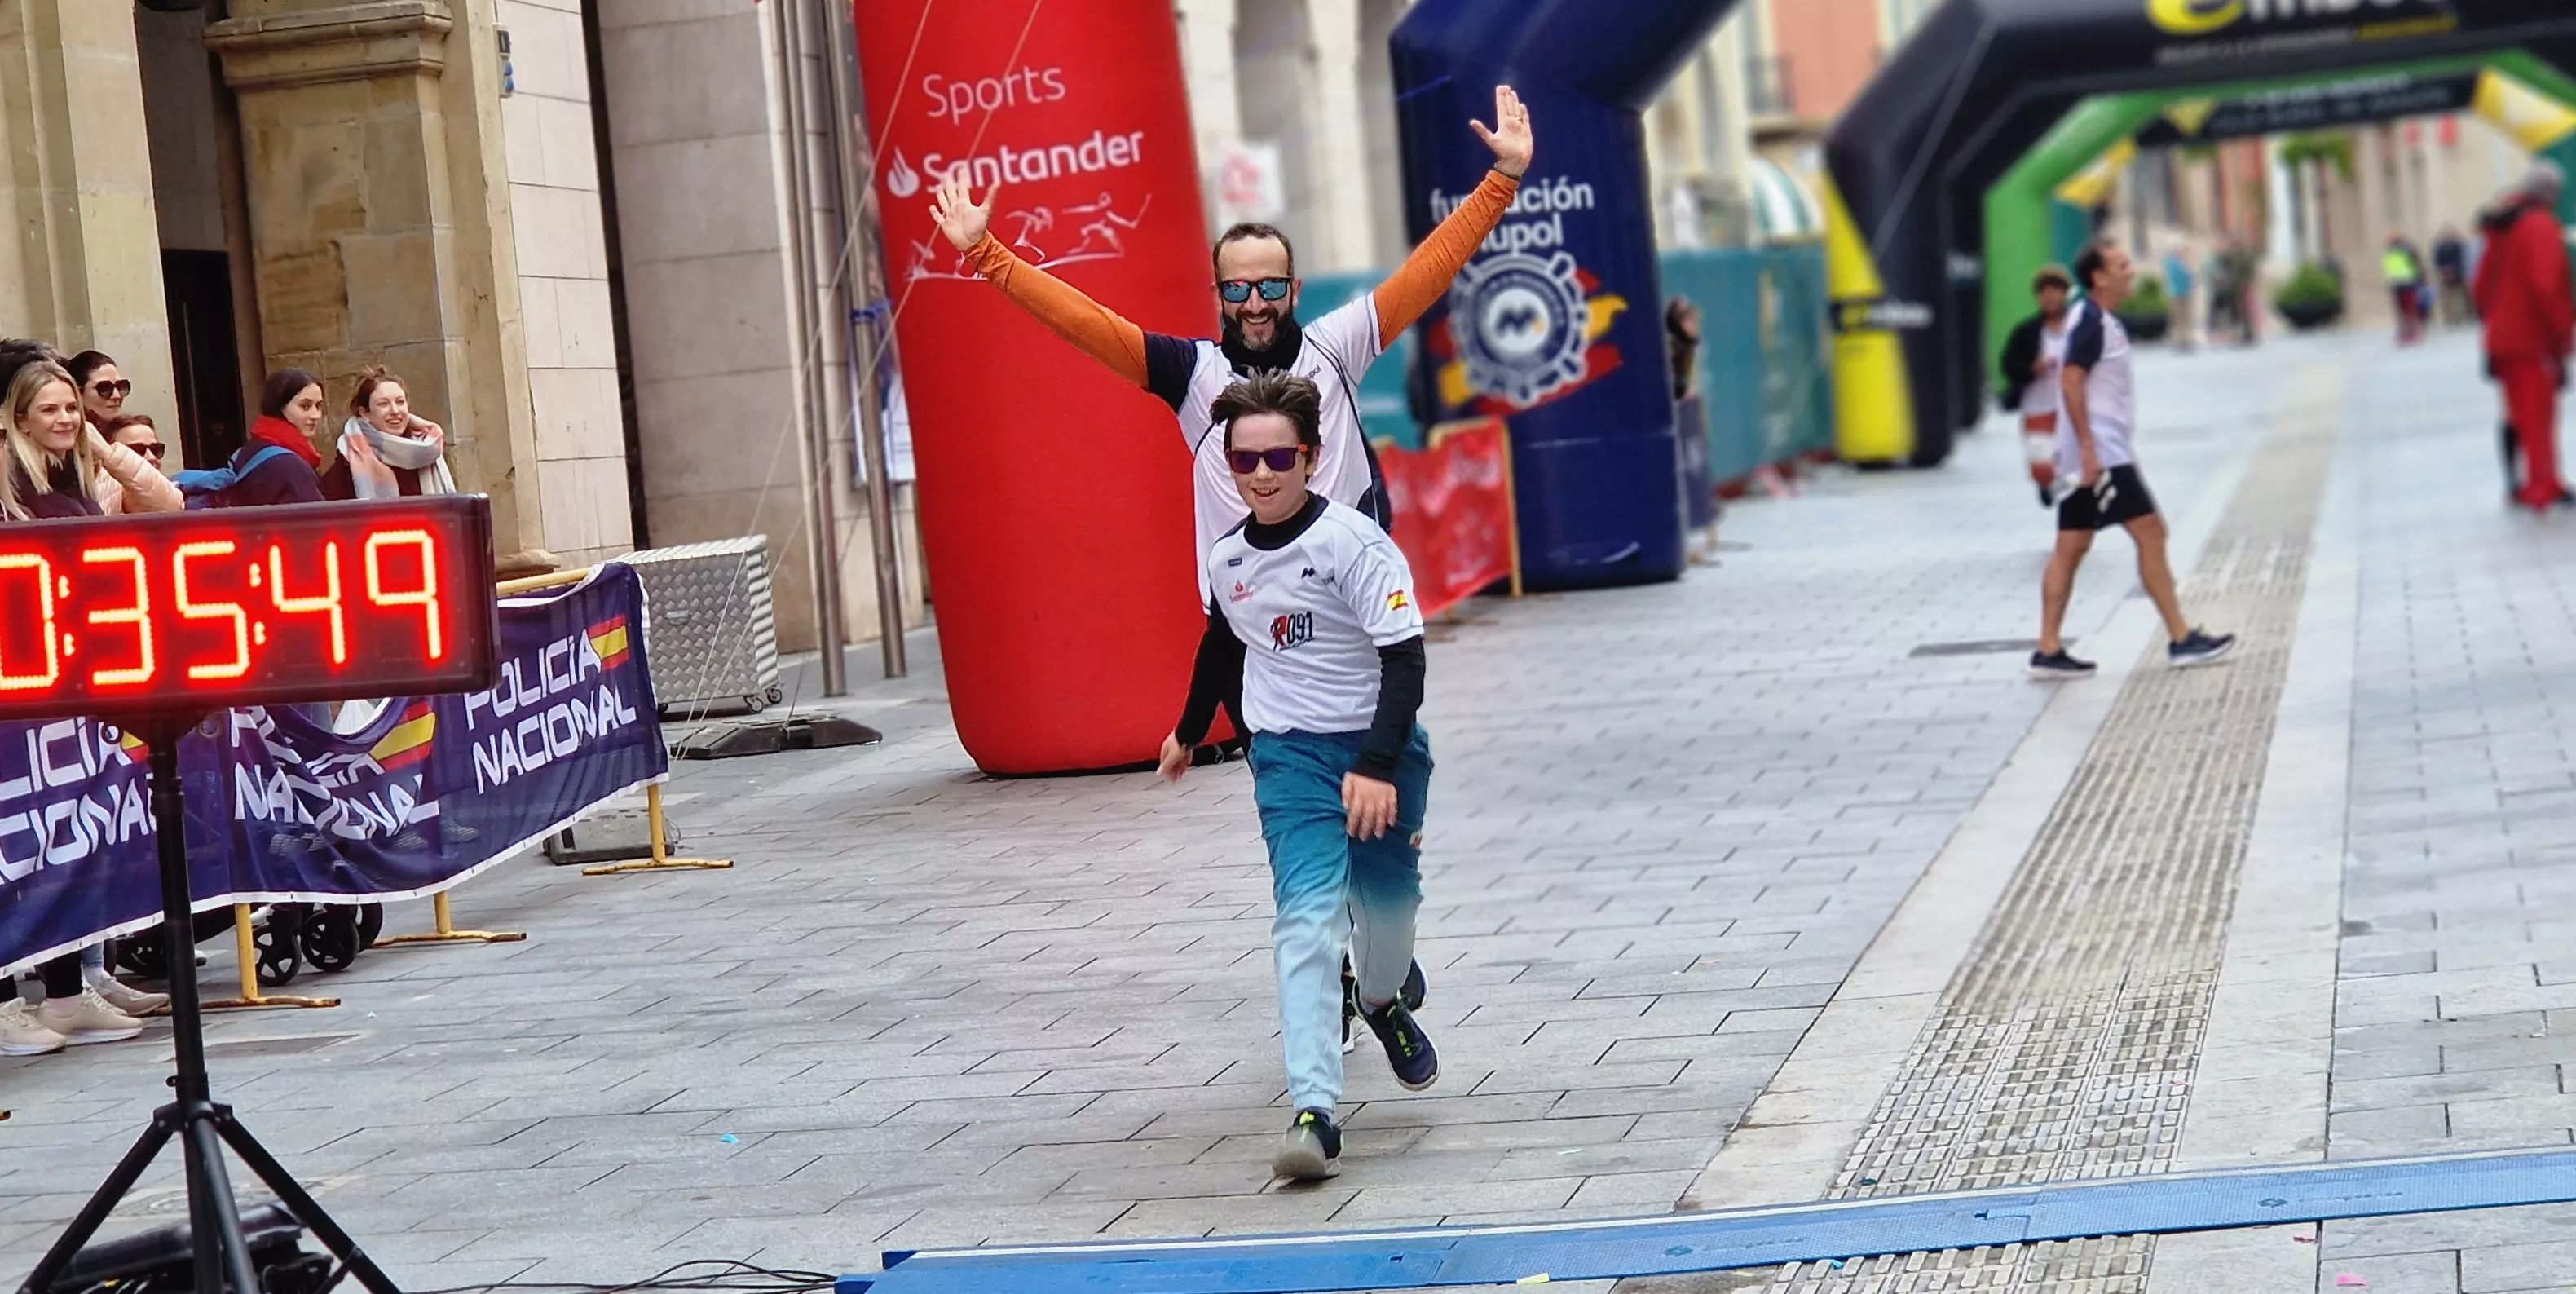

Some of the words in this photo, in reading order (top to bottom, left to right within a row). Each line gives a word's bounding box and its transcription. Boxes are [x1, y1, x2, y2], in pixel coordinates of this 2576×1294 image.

[922, 65, 1066, 125] Sports
[922, 130, 1144, 194] Santander
[1481, 211, 1564, 258] upol
[472, 682, 637, 795] NACIONAL
